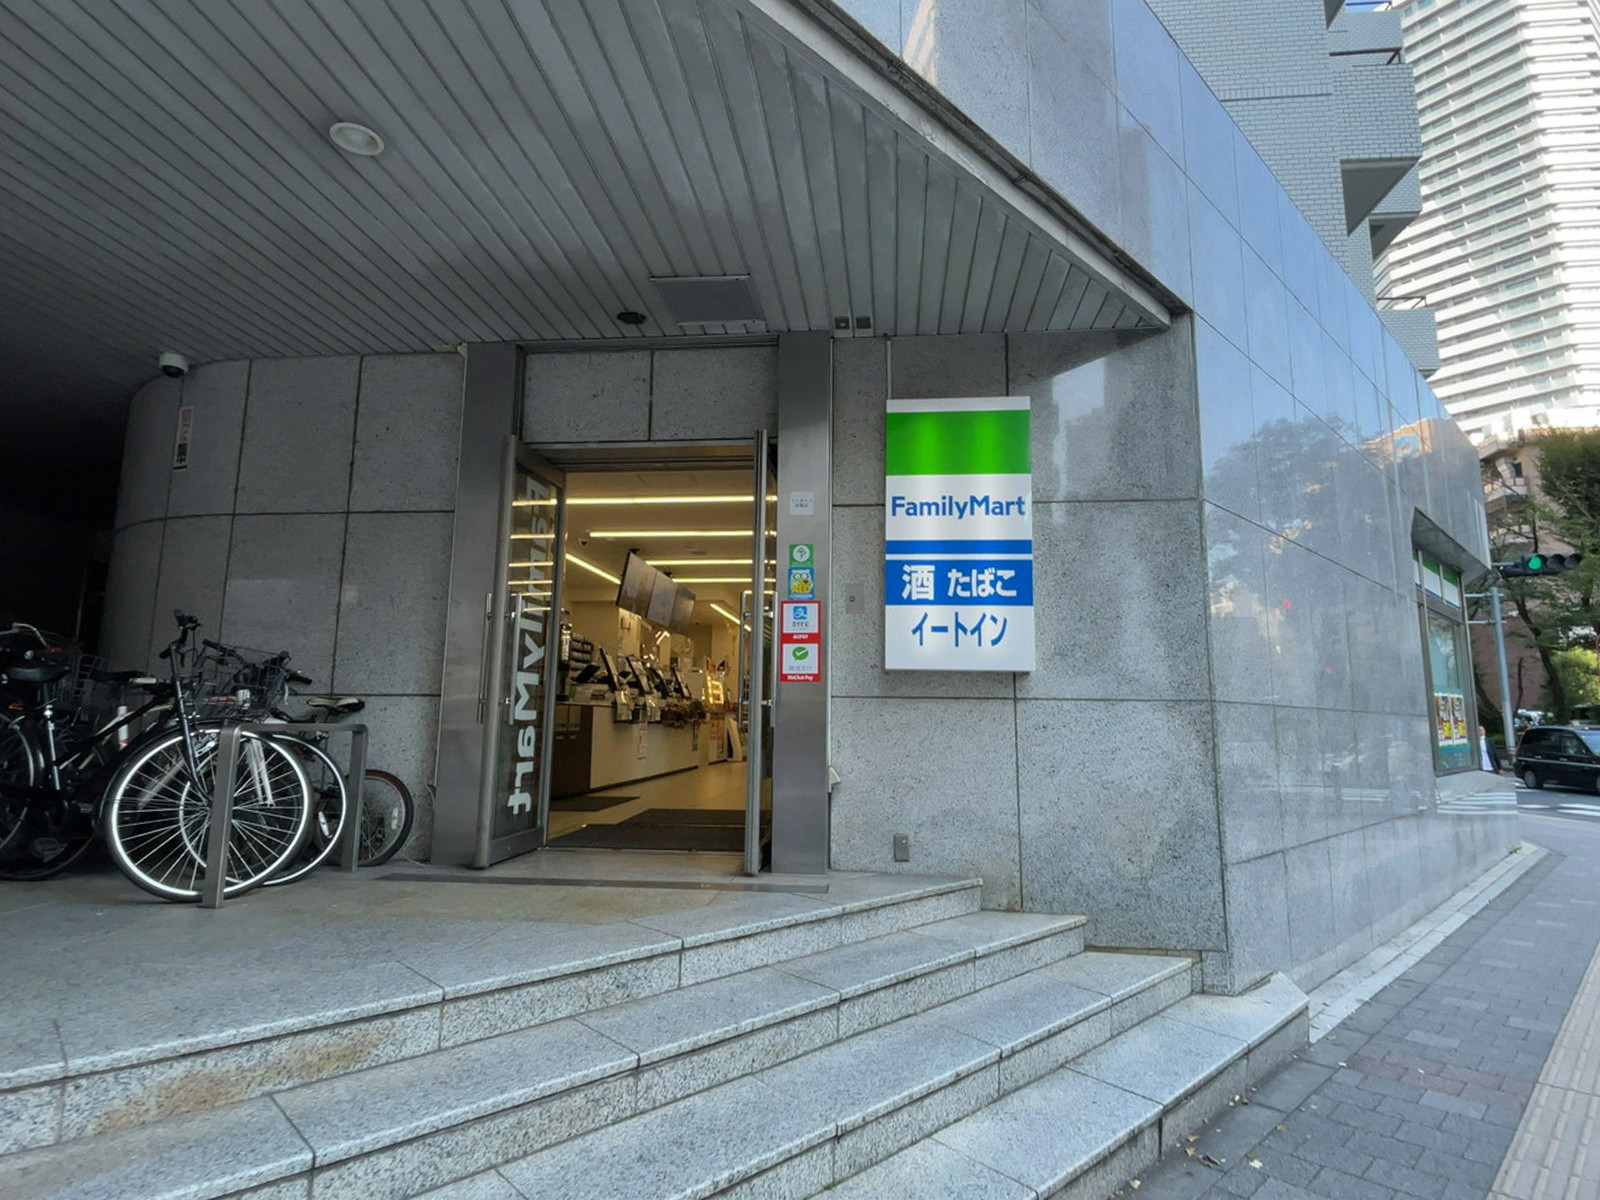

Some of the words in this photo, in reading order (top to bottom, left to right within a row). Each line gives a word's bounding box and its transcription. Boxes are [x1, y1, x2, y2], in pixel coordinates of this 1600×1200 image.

[891, 495, 1026, 519] FamilyMart
[901, 564, 936, 601] 酒
[947, 567, 1017, 598] たばこ
[911, 611, 1008, 648] イートイン
